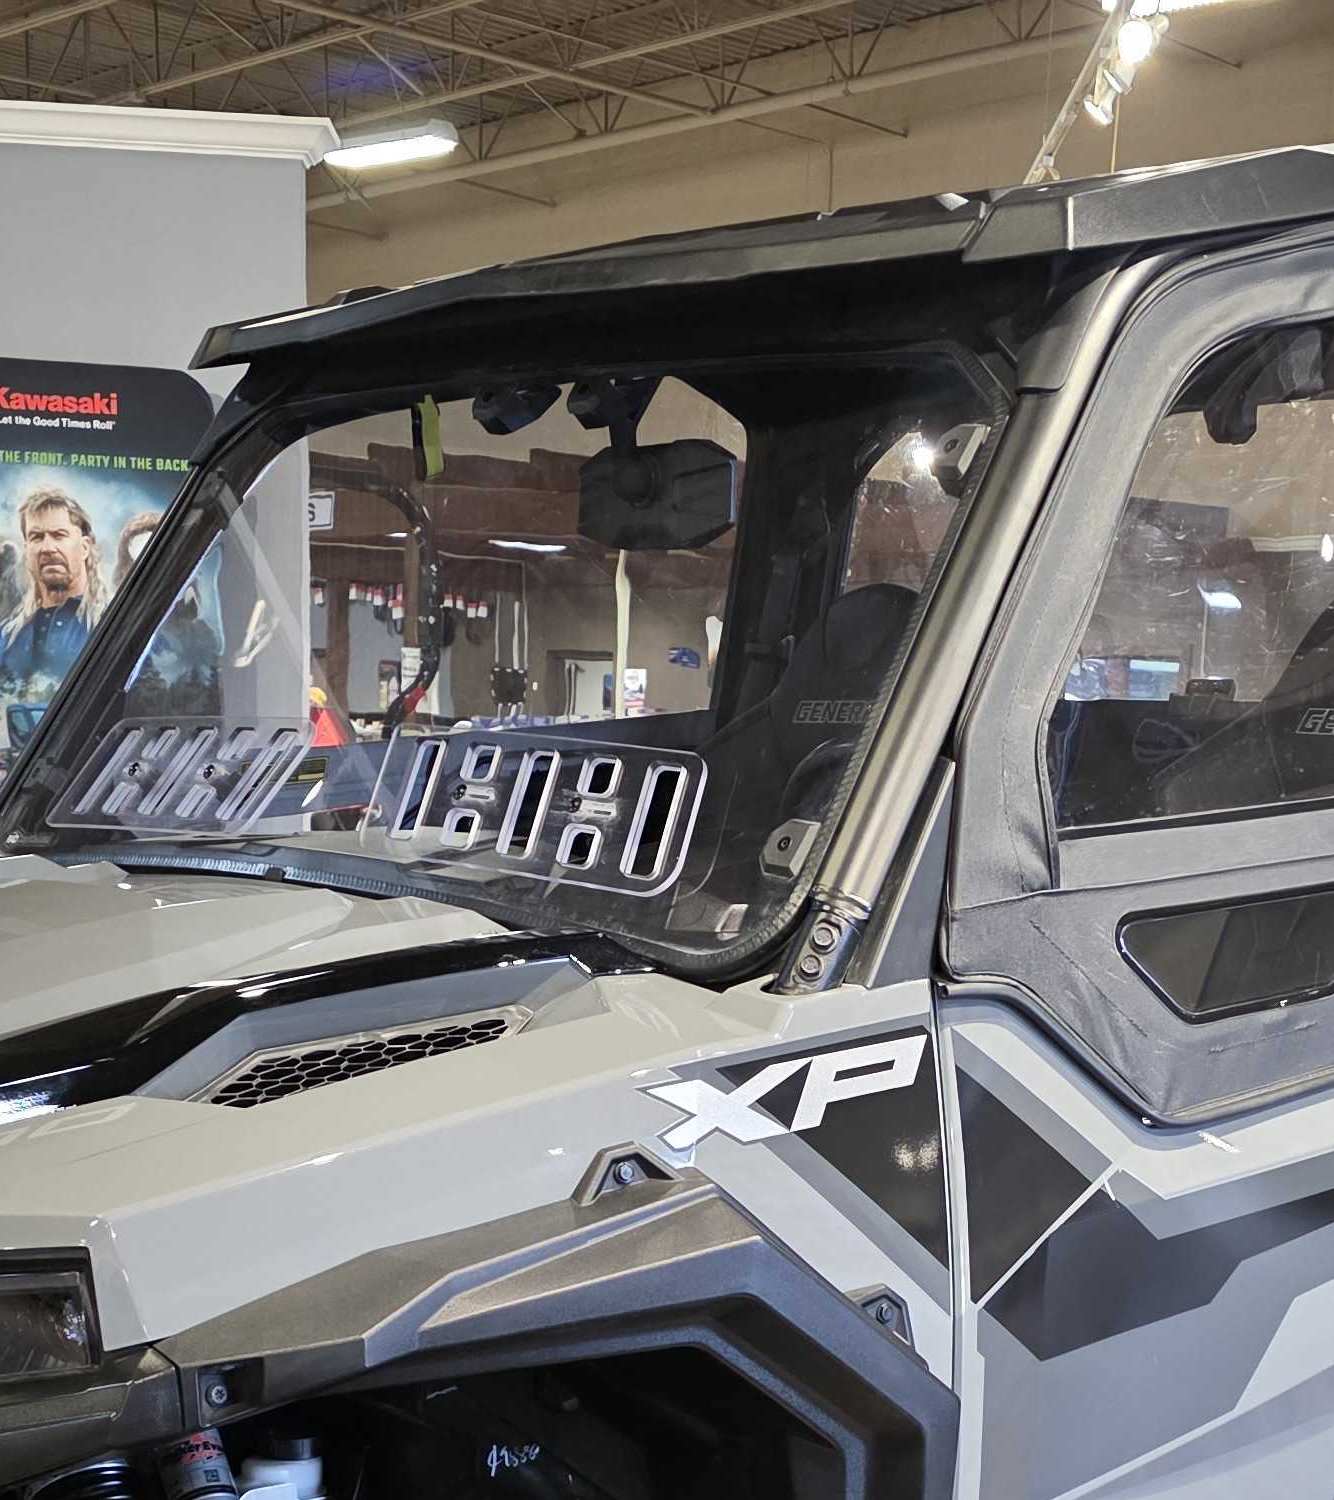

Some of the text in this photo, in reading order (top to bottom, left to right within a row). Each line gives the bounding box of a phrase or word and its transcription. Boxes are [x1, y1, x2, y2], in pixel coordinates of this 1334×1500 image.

[14, 415, 31, 426] the
[32, 416, 59, 427] Good
[61, 418, 91, 429] Times
[93, 420, 113, 430] Roll
[24, 451, 67, 466] FRONT.
[70, 454, 110, 468] PARTY
[113, 456, 127, 469] IN
[129, 457, 153, 470] THE
[792, 699, 875, 723] GENER
[646, 1034, 928, 1149] XP
